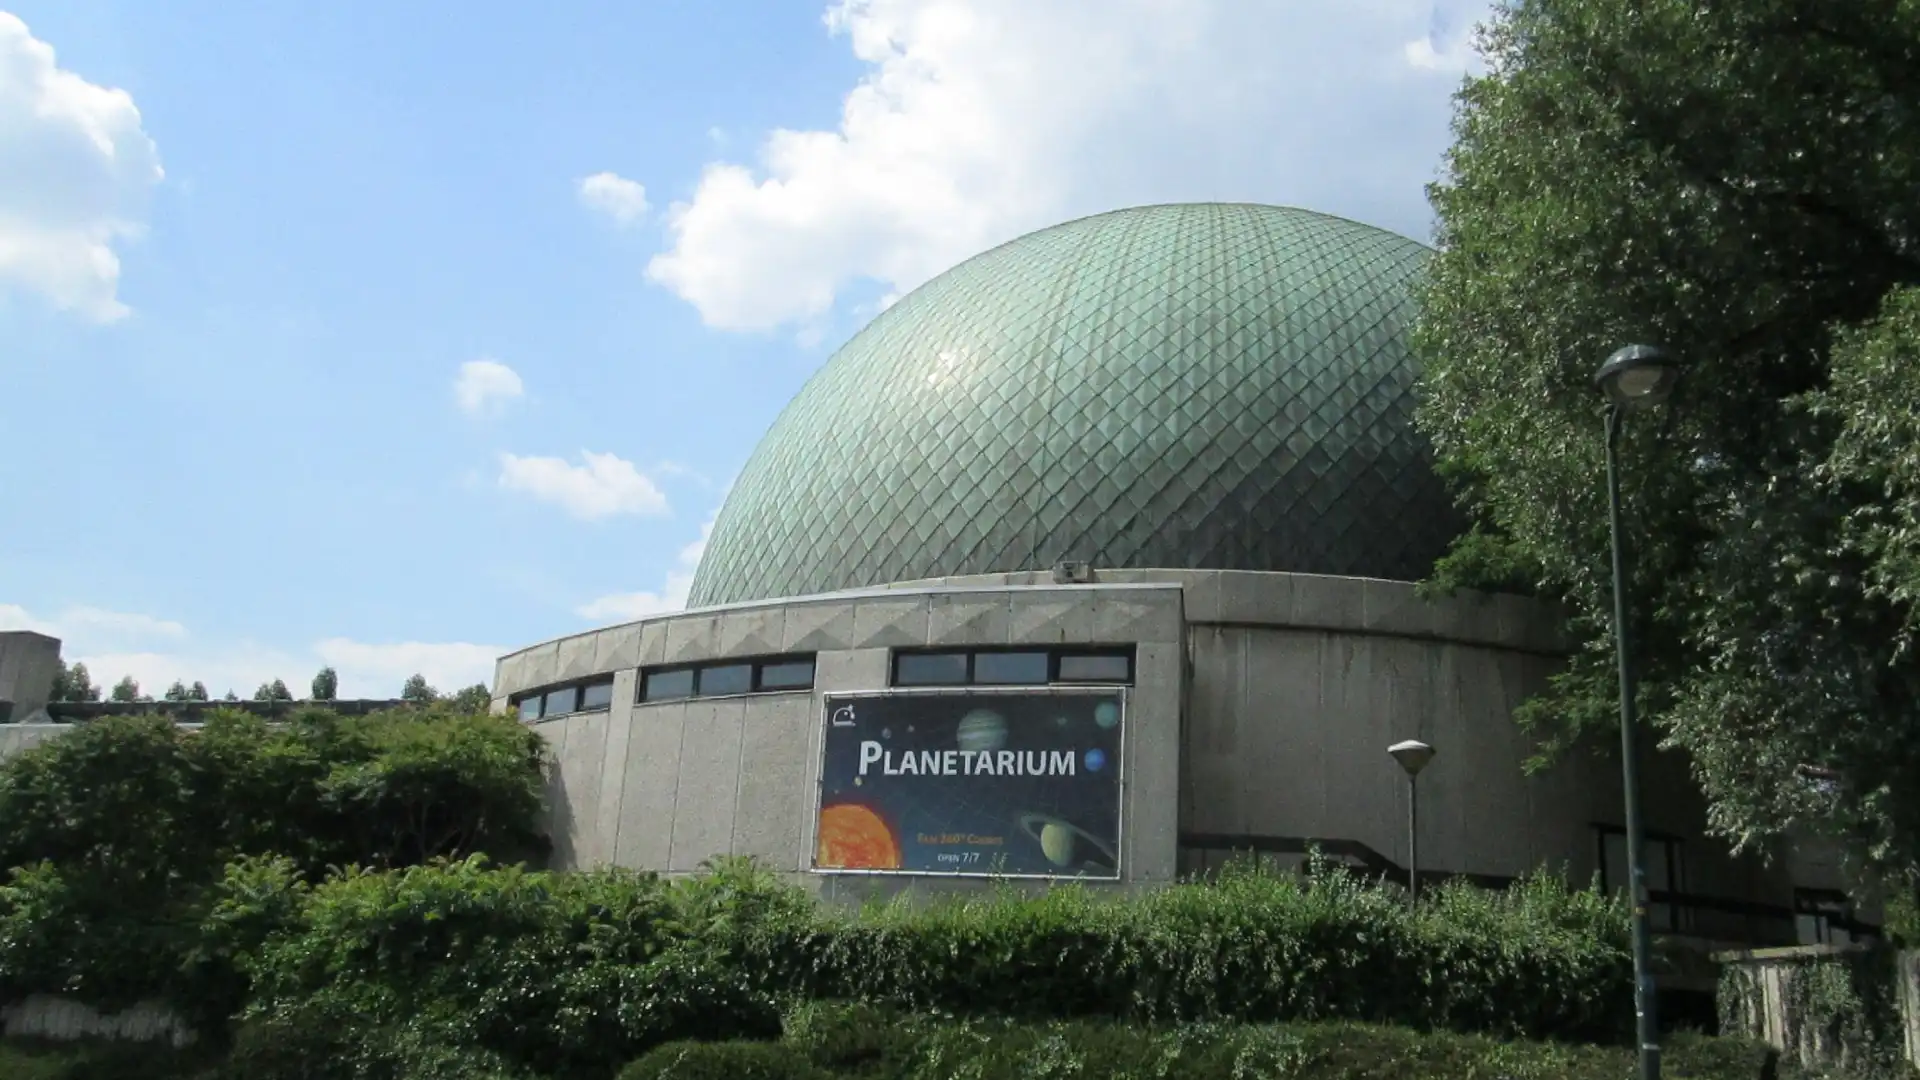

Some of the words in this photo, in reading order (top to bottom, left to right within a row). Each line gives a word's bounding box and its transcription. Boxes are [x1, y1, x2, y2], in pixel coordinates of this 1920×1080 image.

[858, 740, 1076, 776] PLANETARIUM
[937, 853, 960, 862] OPEN
[962, 852, 980, 863] 7/7
